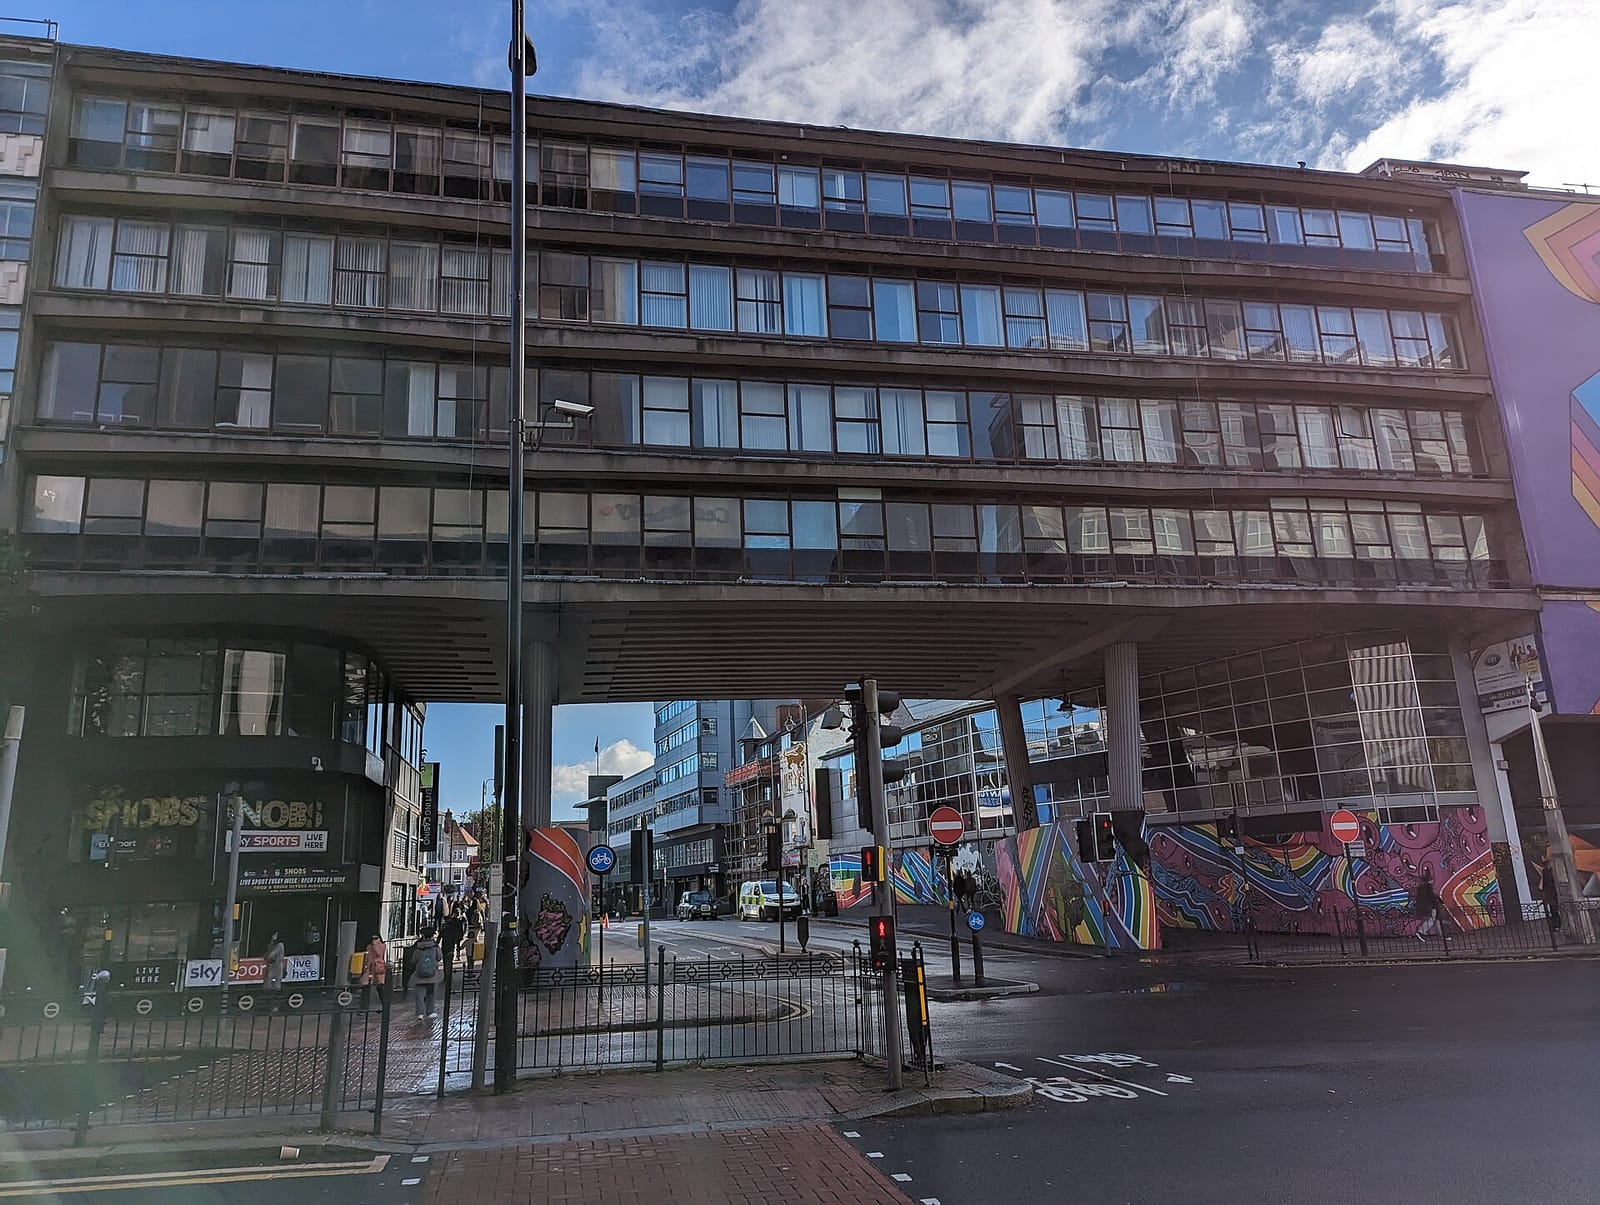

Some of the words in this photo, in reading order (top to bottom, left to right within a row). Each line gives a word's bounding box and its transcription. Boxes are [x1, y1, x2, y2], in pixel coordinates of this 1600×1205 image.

[424, 788, 433, 816] ENTING
[422, 816, 431, 846] CASINO
[253, 836, 299, 846] SPORTS
[306, 833, 323, 841] LIVE
[304, 841, 324, 849] HERE
[284, 867, 307, 875] SNOBS
[293, 958, 312, 967] live
[136, 966, 161, 974] LIVE
[190, 964, 221, 980] sky
[292, 968, 317, 978] here
[135, 975, 160, 983] HERE
